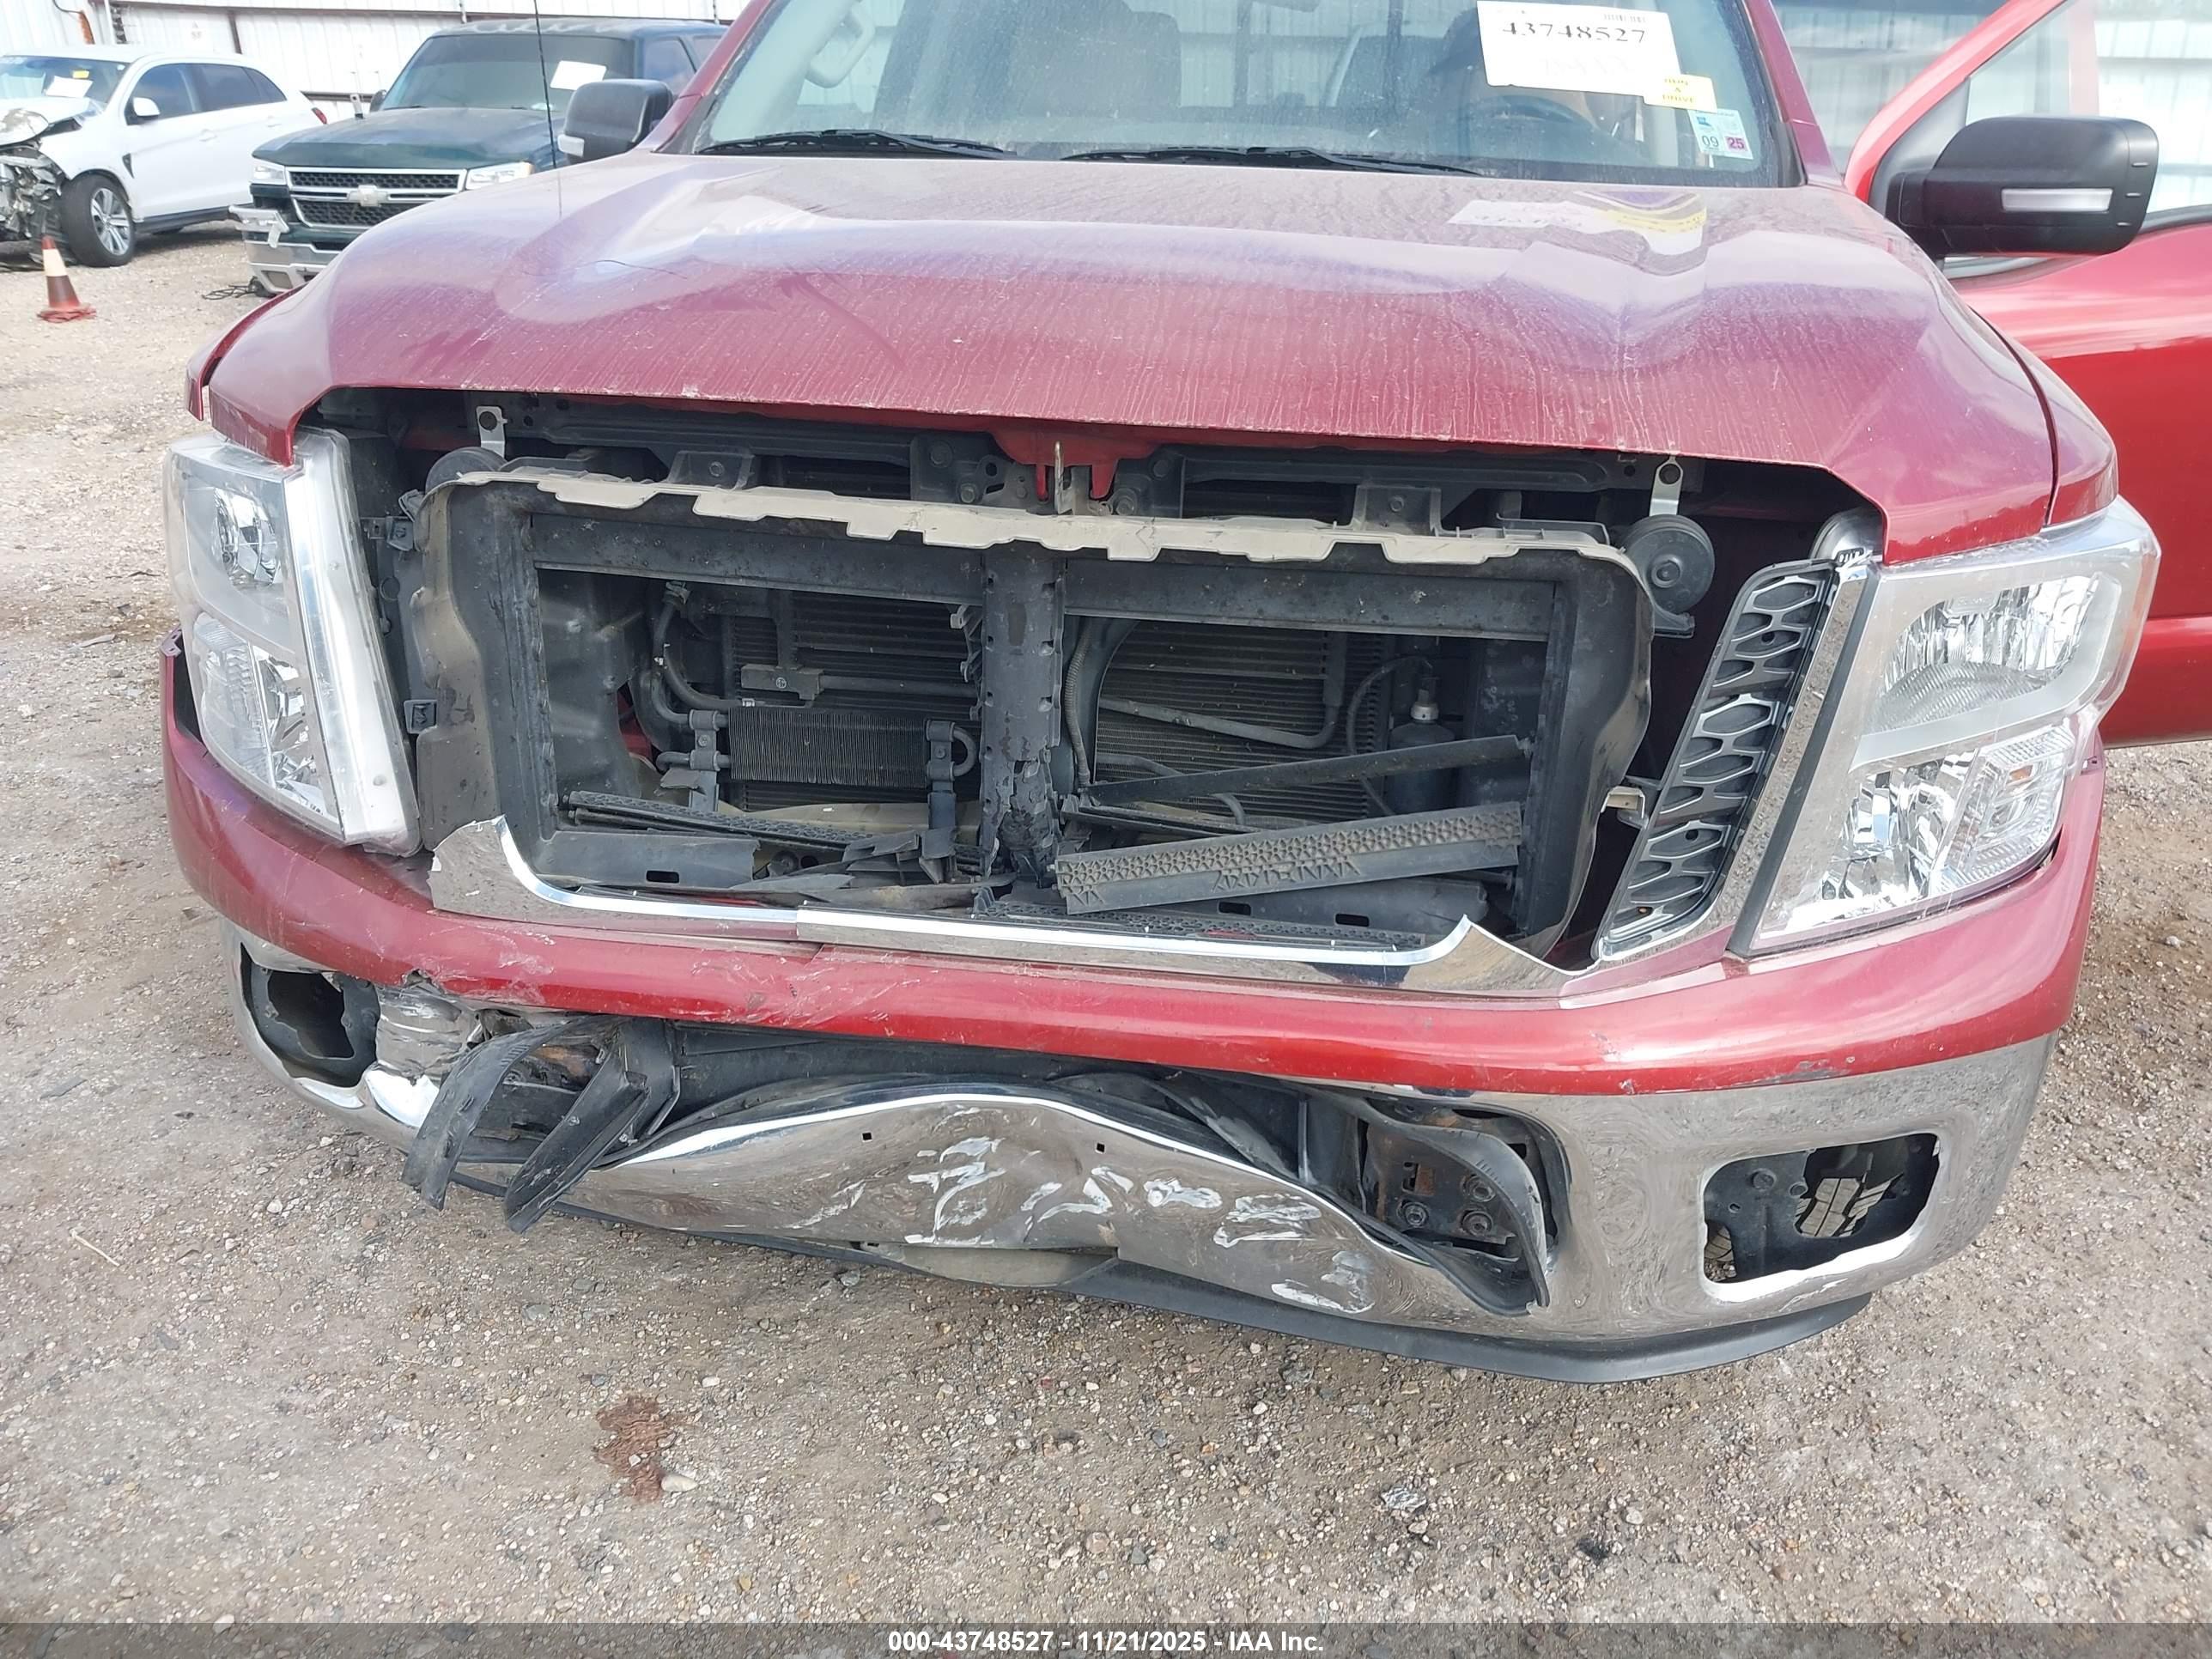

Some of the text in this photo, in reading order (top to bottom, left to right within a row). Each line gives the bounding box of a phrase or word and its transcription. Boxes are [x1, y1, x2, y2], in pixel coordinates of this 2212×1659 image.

[1502, 21, 1647, 44] 43748527
[1701, 135, 1745, 149] 09 25
